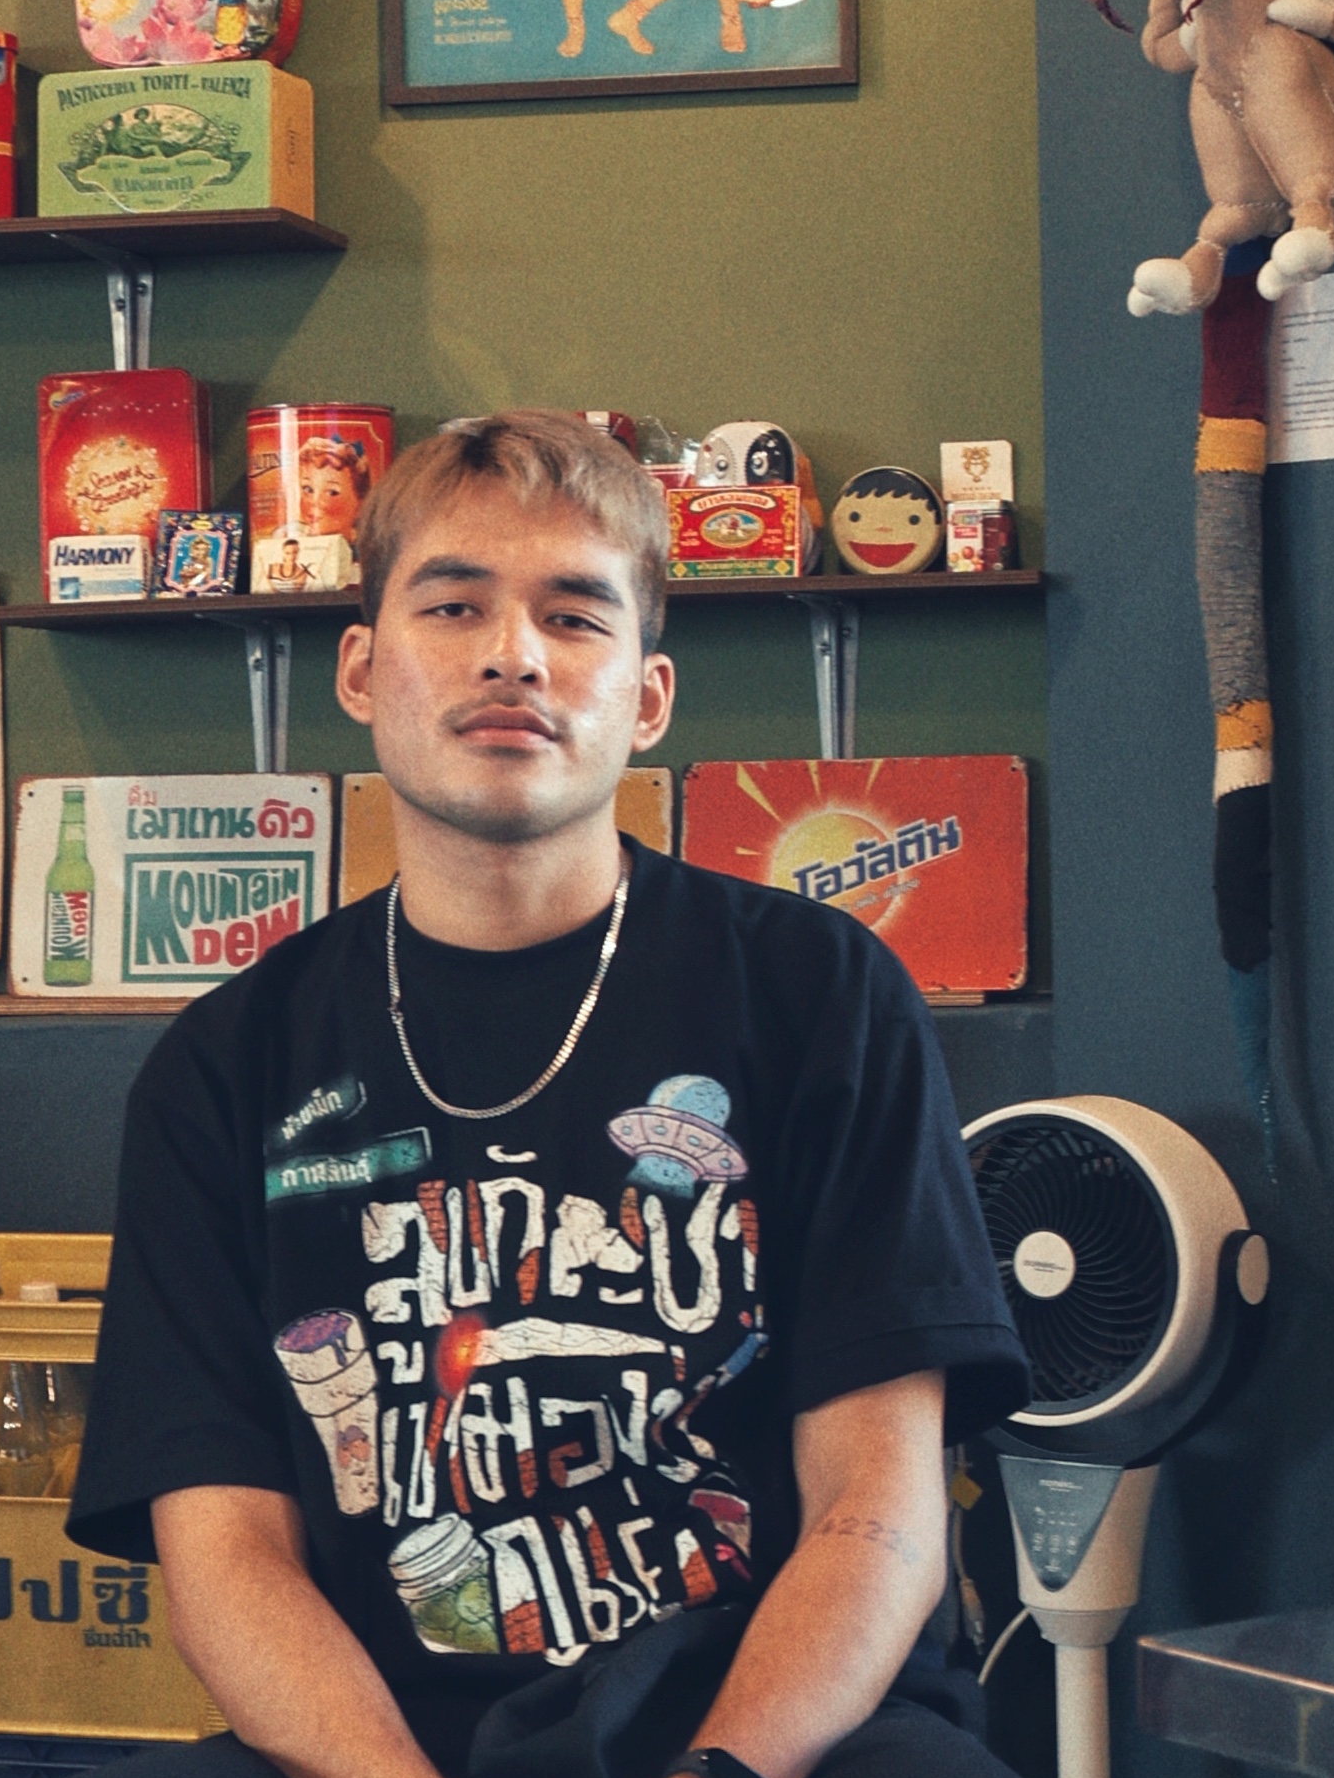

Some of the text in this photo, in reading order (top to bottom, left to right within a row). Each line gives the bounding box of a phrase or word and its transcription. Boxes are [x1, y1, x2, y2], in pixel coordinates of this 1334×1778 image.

[57, 73, 251, 111] PASTICCERIA TORTI VALENZA
[54, 545, 136, 567] HARMONY
